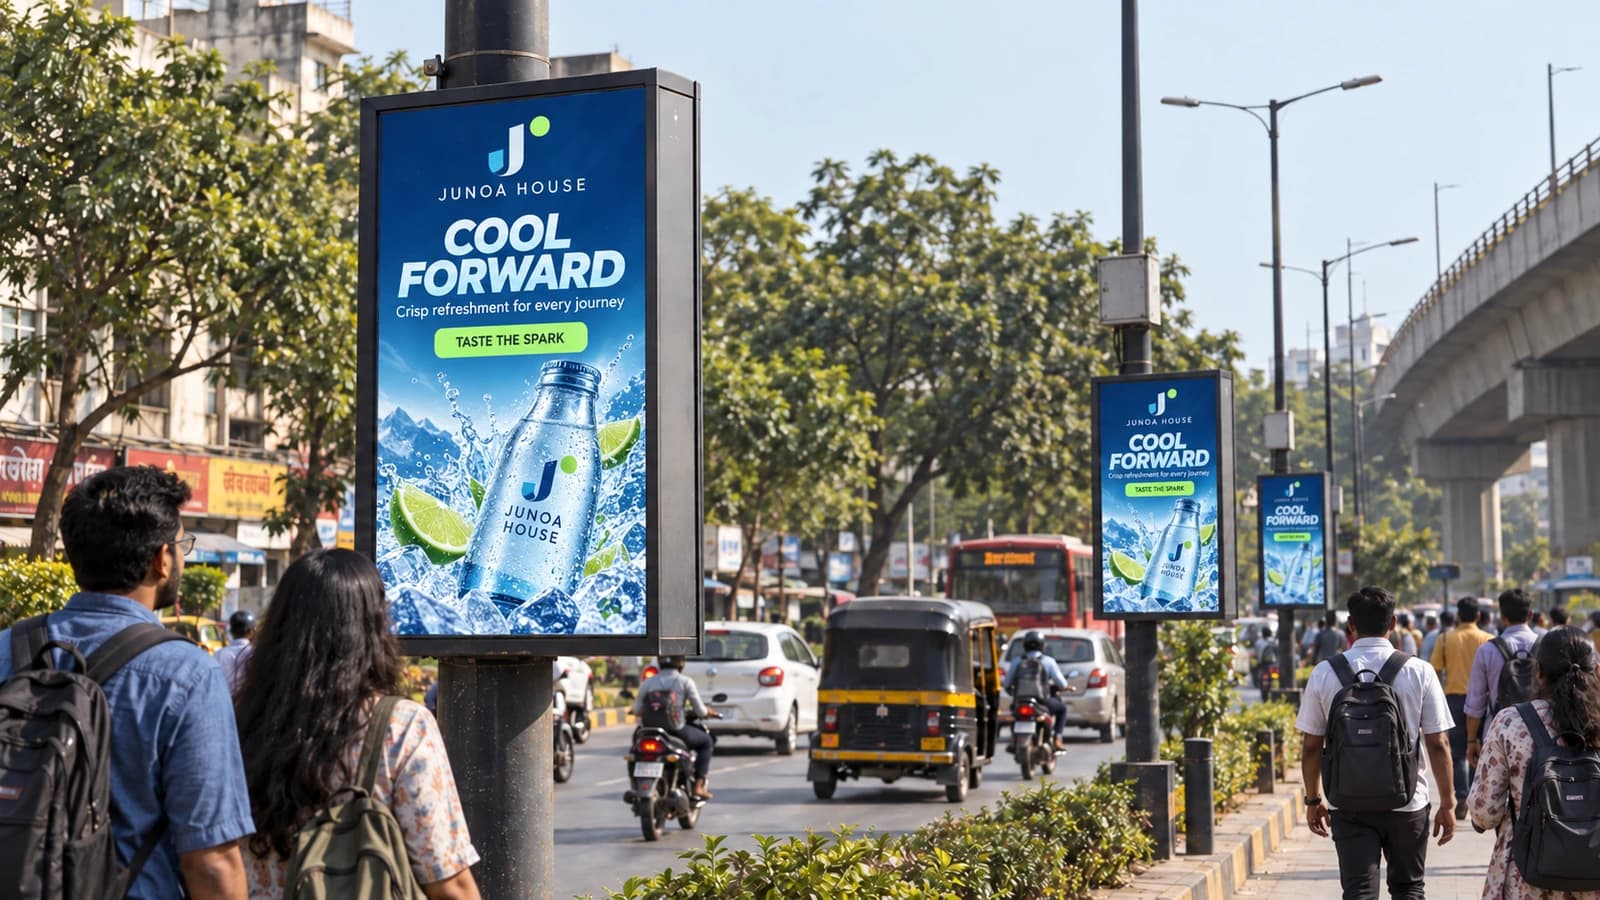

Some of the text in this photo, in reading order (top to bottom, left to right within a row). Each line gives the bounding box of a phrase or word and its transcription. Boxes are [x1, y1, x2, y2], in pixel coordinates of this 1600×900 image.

[438, 178, 586, 201] JUNOA HOUSE
[444, 212, 571, 256] COOL
[397, 250, 626, 298] FORWARD
[396, 297, 625, 320] Crisp refreshment for every journey
[456, 332, 565, 348] TASTE THE SPARK
[1126, 417, 1193, 427] JUNOA HOUSE
[1129, 432, 1187, 452] COOL
[1109, 449, 1210, 471] FORWARD
[504, 504, 562, 528] JUNOA
[1266, 515, 1319, 526] FORWARD
[1275, 505, 1306, 515] COOL
[503, 520, 559, 544] HOUSE
